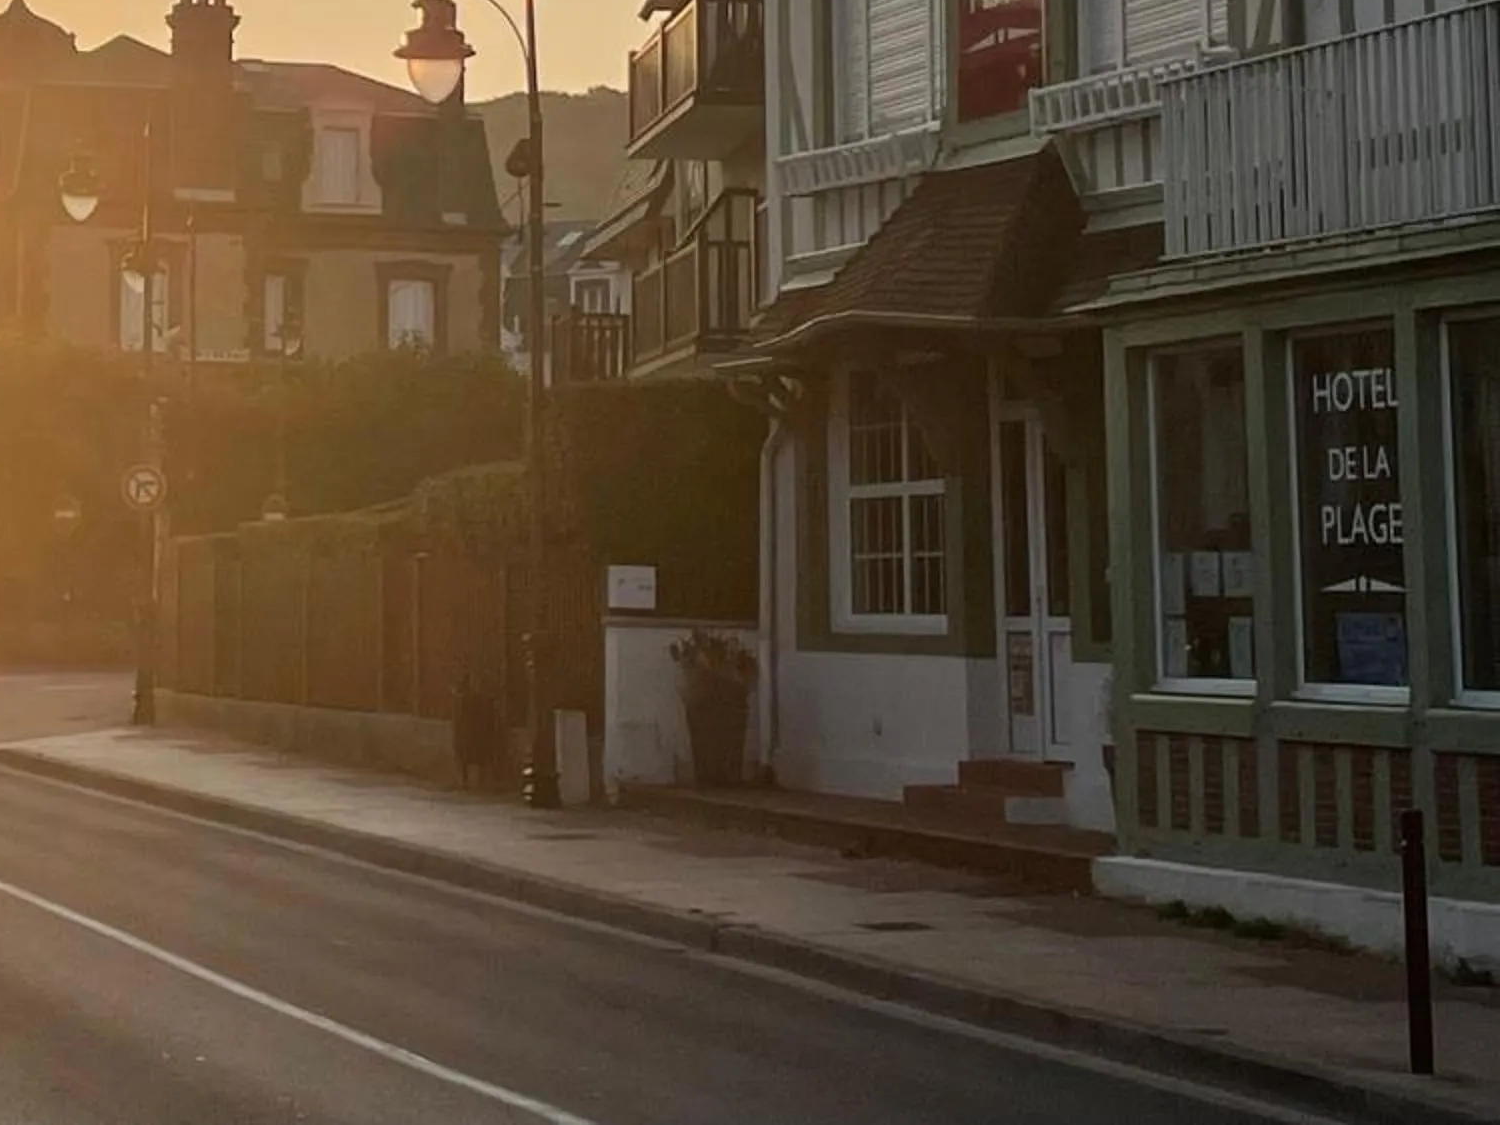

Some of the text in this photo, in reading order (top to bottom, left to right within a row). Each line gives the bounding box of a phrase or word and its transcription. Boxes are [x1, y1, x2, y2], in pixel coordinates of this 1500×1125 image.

[1312, 366, 1400, 413] HOTEL
[1327, 444, 1392, 481] DE LA
[1320, 502, 1405, 546] PLAGE
